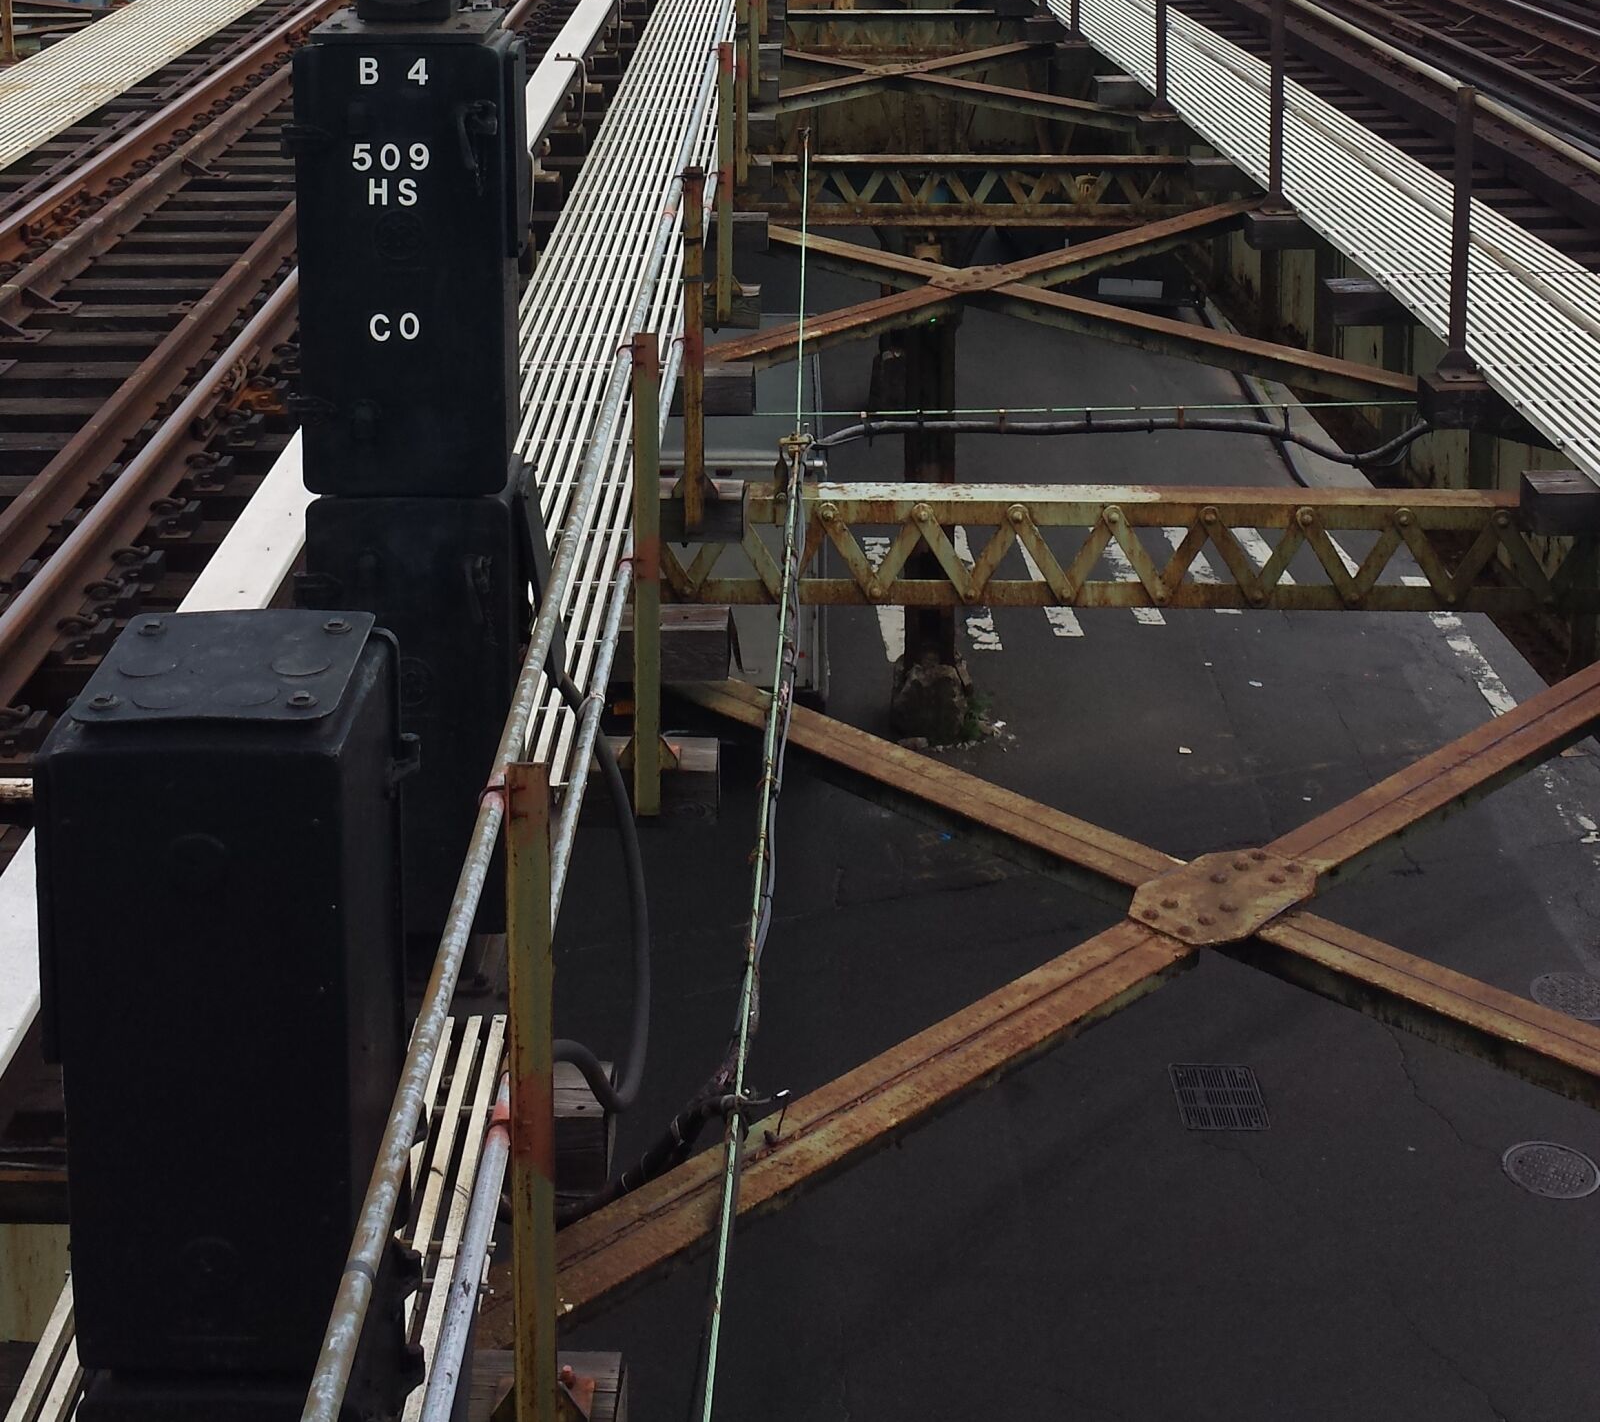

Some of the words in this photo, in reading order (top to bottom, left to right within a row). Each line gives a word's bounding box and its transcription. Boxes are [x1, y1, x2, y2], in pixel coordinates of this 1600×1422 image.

[360, 58, 378, 85] B
[407, 58, 428, 85] 4
[352, 143, 430, 171] 509
[369, 178, 418, 206] HS
